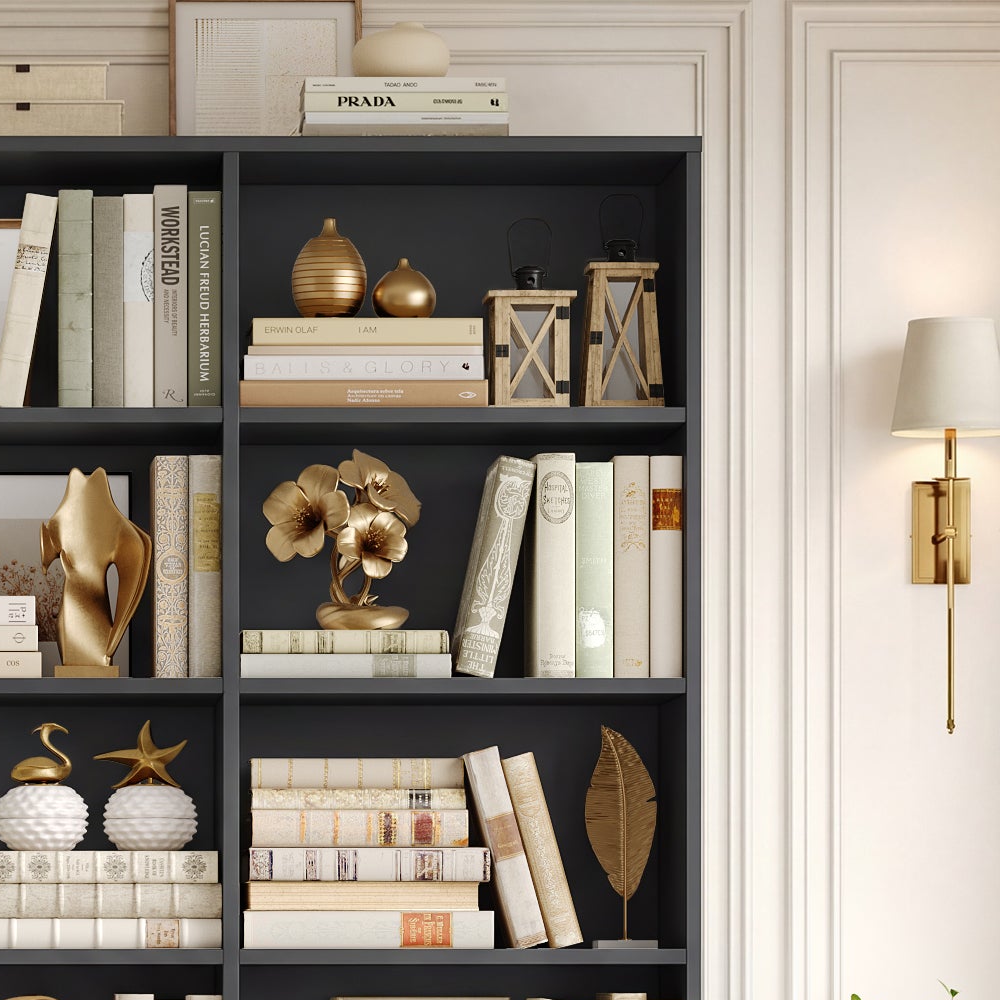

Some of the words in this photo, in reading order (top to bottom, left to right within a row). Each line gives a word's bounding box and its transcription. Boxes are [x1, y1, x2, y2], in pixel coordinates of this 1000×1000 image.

[337, 96, 396, 107] PRADA
[161, 206, 180, 286] WORKSTEAD
[199, 225, 210, 269] LUCIAN
[199, 272, 210, 310] FREUD
[264, 326, 293, 334] ERWIN
[295, 326, 318, 334] OLAF
[362, 326, 377, 334] AM
[199, 313, 210, 382] HERBARIUM
[342, 361, 353, 374] &
[364, 360, 451, 374] GLORY
[544, 482, 569, 492] HOSPITAL
[543, 495, 571, 505] SKETCHES
[462, 639, 498, 653] MINISTER
[463, 650, 494, 661] LITTLE
[468, 661, 486, 671] THE
